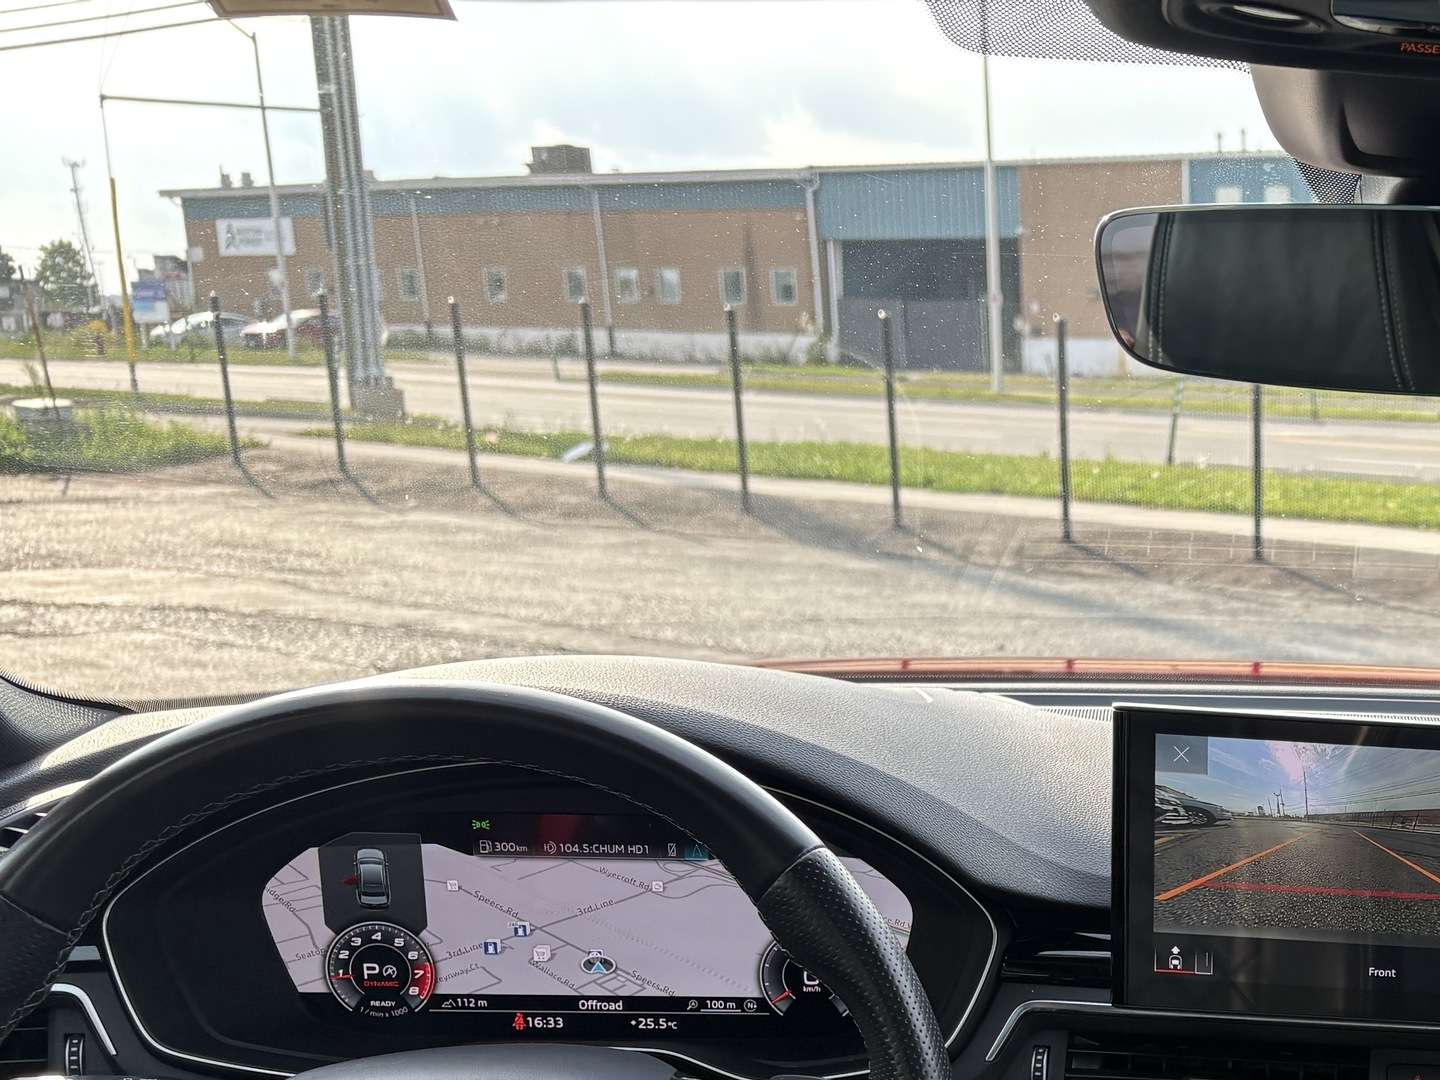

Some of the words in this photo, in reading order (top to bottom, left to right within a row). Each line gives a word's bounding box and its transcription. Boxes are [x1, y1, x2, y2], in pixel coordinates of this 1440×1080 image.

[629, 845, 649, 854] HD1
[474, 890, 503, 911] Speers
[506, 906, 519, 918] Rd
[577, 904, 594, 916] 3rd
[595, 898, 614, 911] Line
[371, 932, 382, 940] 4
[351, 937, 361, 946] 3
[394, 938, 404, 947] 5
[338, 950, 350, 959] 2
[408, 951, 418, 960] 6
[447, 947, 464, 960] 3rd
[338, 969, 344, 977] 1
[363, 963, 380, 979] P
[414, 970, 424, 979] 7
[436, 967, 469, 983] eynway
[1369, 967, 1396, 978] Front
[564, 978, 575, 990] Rd
[631, 970, 660, 990] Speers
[409, 986, 419, 995] 8
[803, 985, 821, 993] km/h
[457, 998, 476, 1007] 112
[579, 1000, 623, 1010] Offroad
[706, 1000, 724, 1009] 100
[527, 1017, 564, 1028] 16:33
